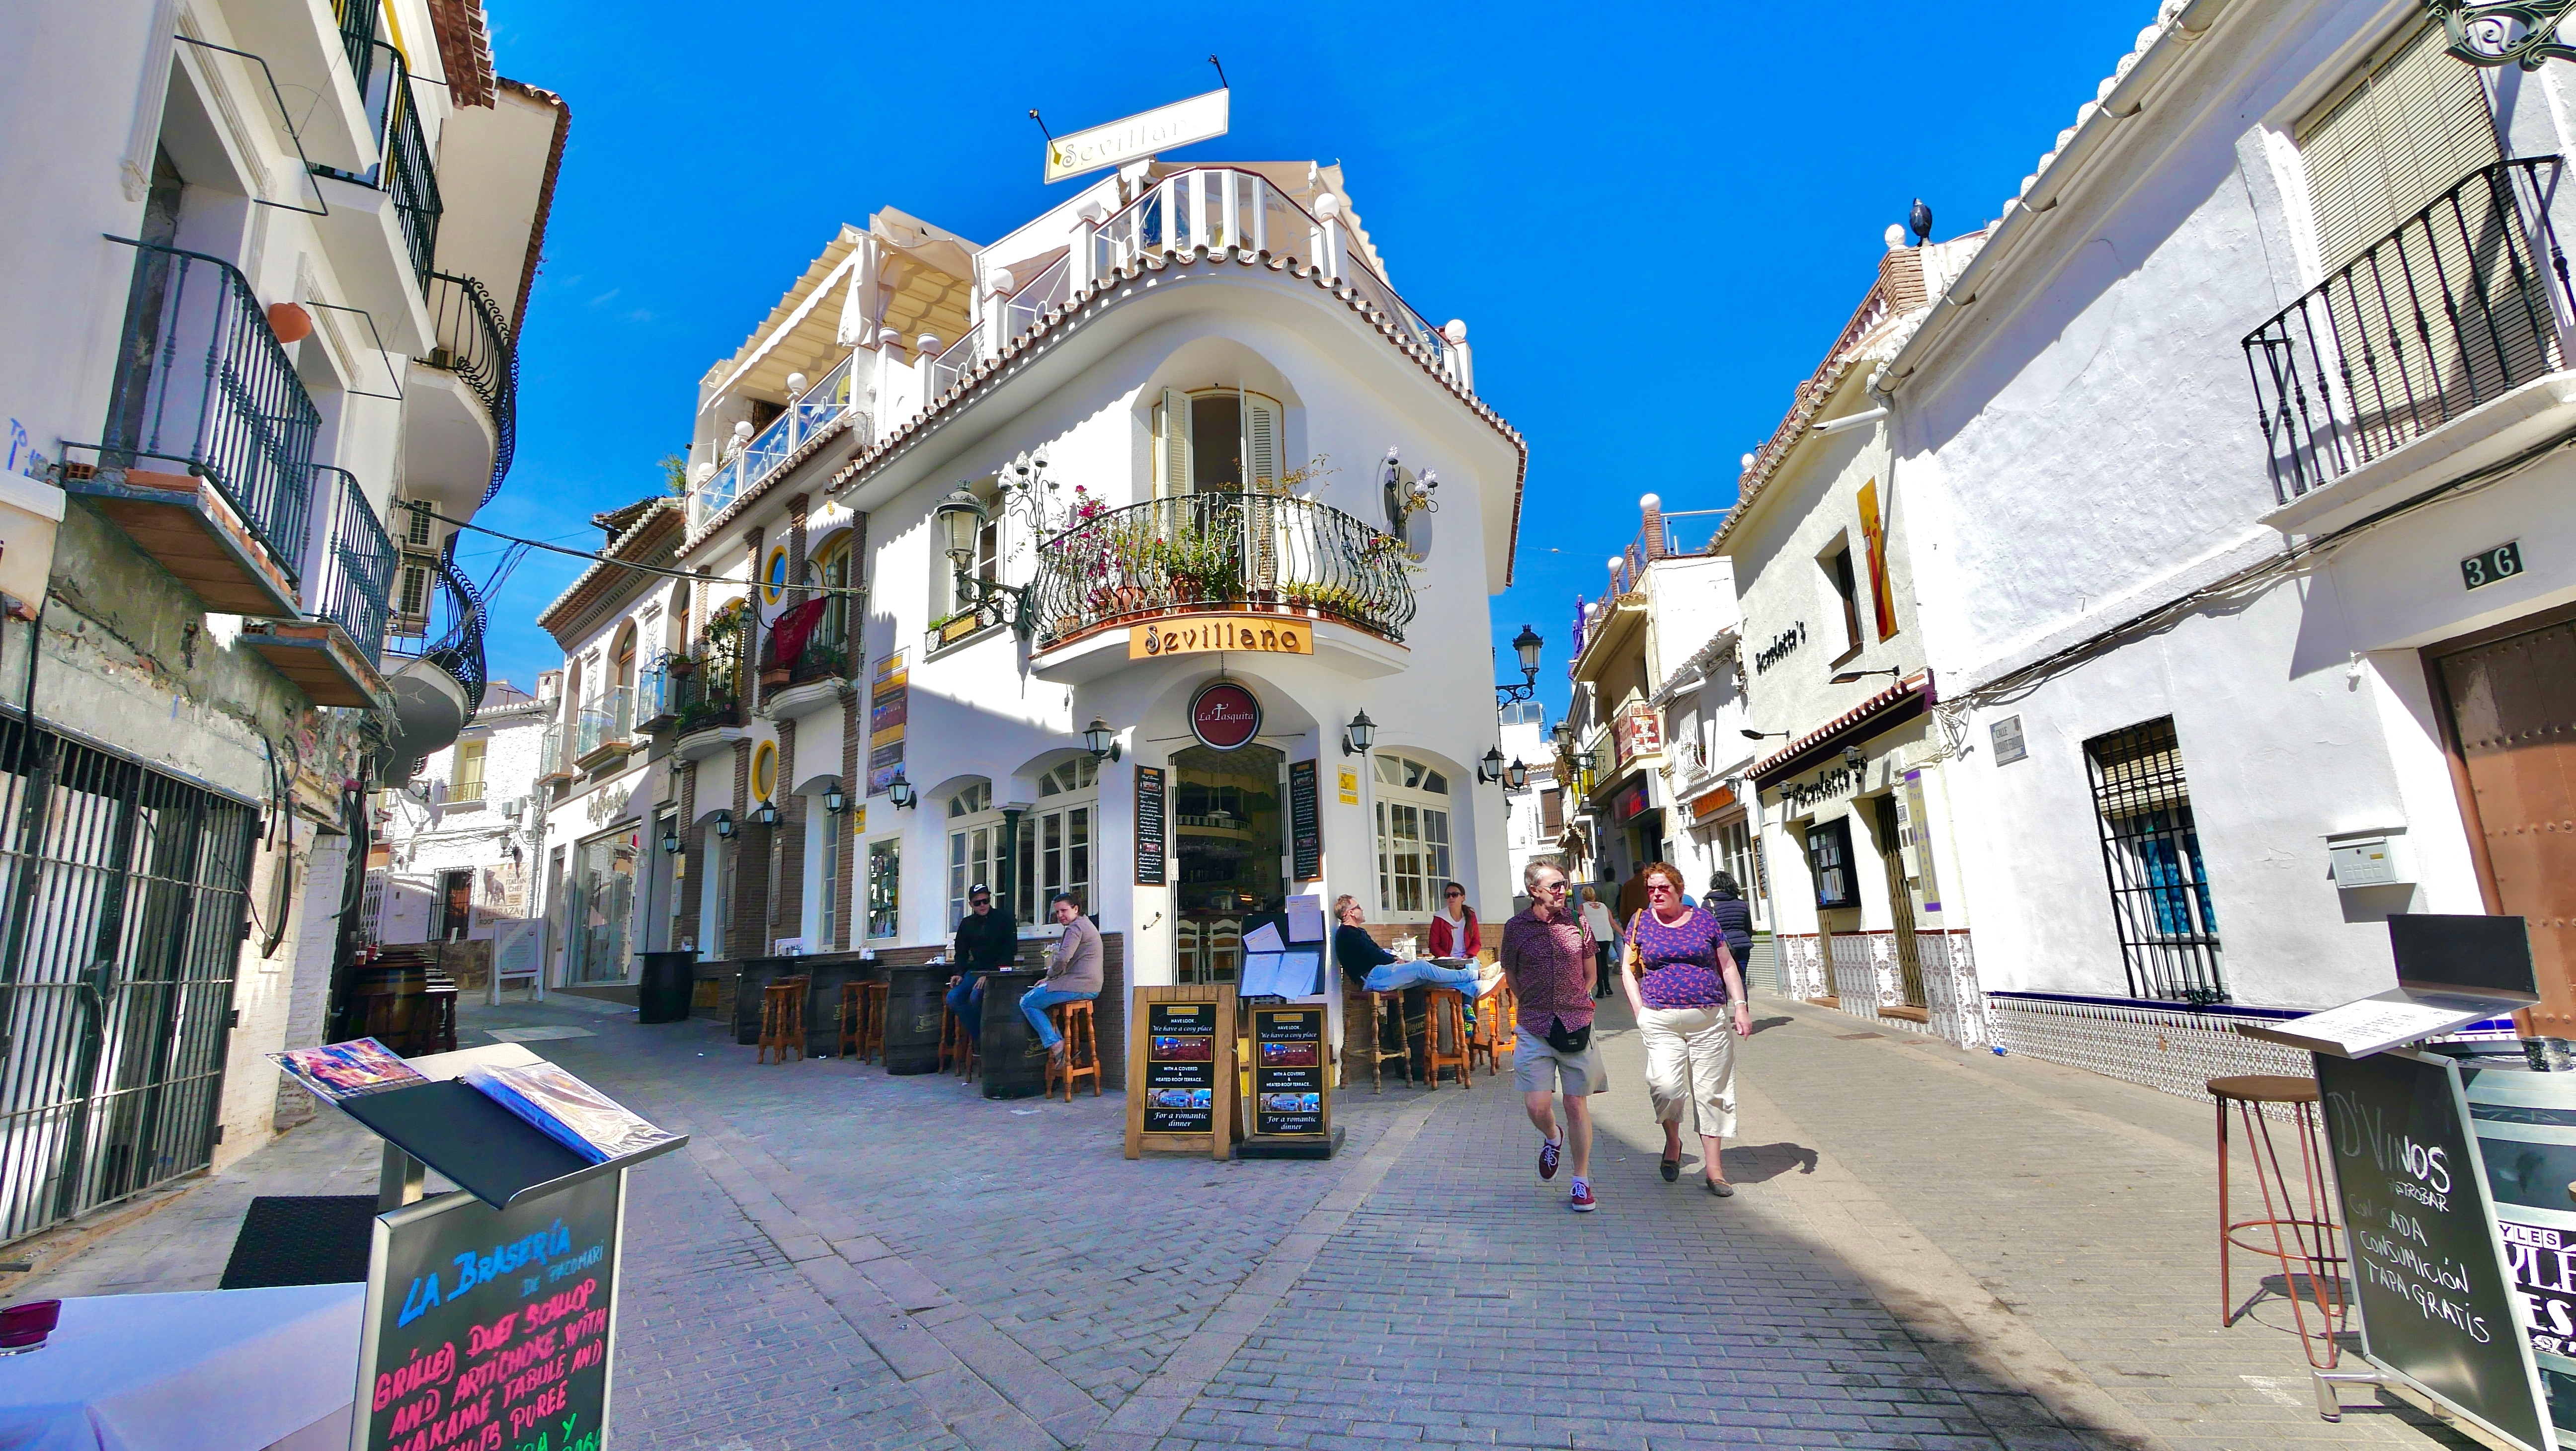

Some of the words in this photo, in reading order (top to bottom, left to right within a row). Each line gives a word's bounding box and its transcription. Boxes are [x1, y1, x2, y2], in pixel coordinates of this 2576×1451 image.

[2466, 547, 2514, 585] 36
[1145, 622, 1298, 654] Sevillano
[1198, 712, 1210, 721] La
[1211, 703, 1253, 724] Tasquita
[1909, 781, 1919, 790] Roof
[1910, 793, 1921, 801] Top
[483, 907, 519, 917] TERRAZA
[2380, 1208, 2427, 1247] CADA
[2499, 1224, 2558, 1246] YLES
[520, 1275, 541, 1297] DE
[2362, 1256, 2410, 1300] TAPA
[399, 1272, 440, 1328] LA
[570, 1338, 603, 1373] AND
[388, 1389, 441, 1440] AND
[562, 1413, 577, 1443] Y
